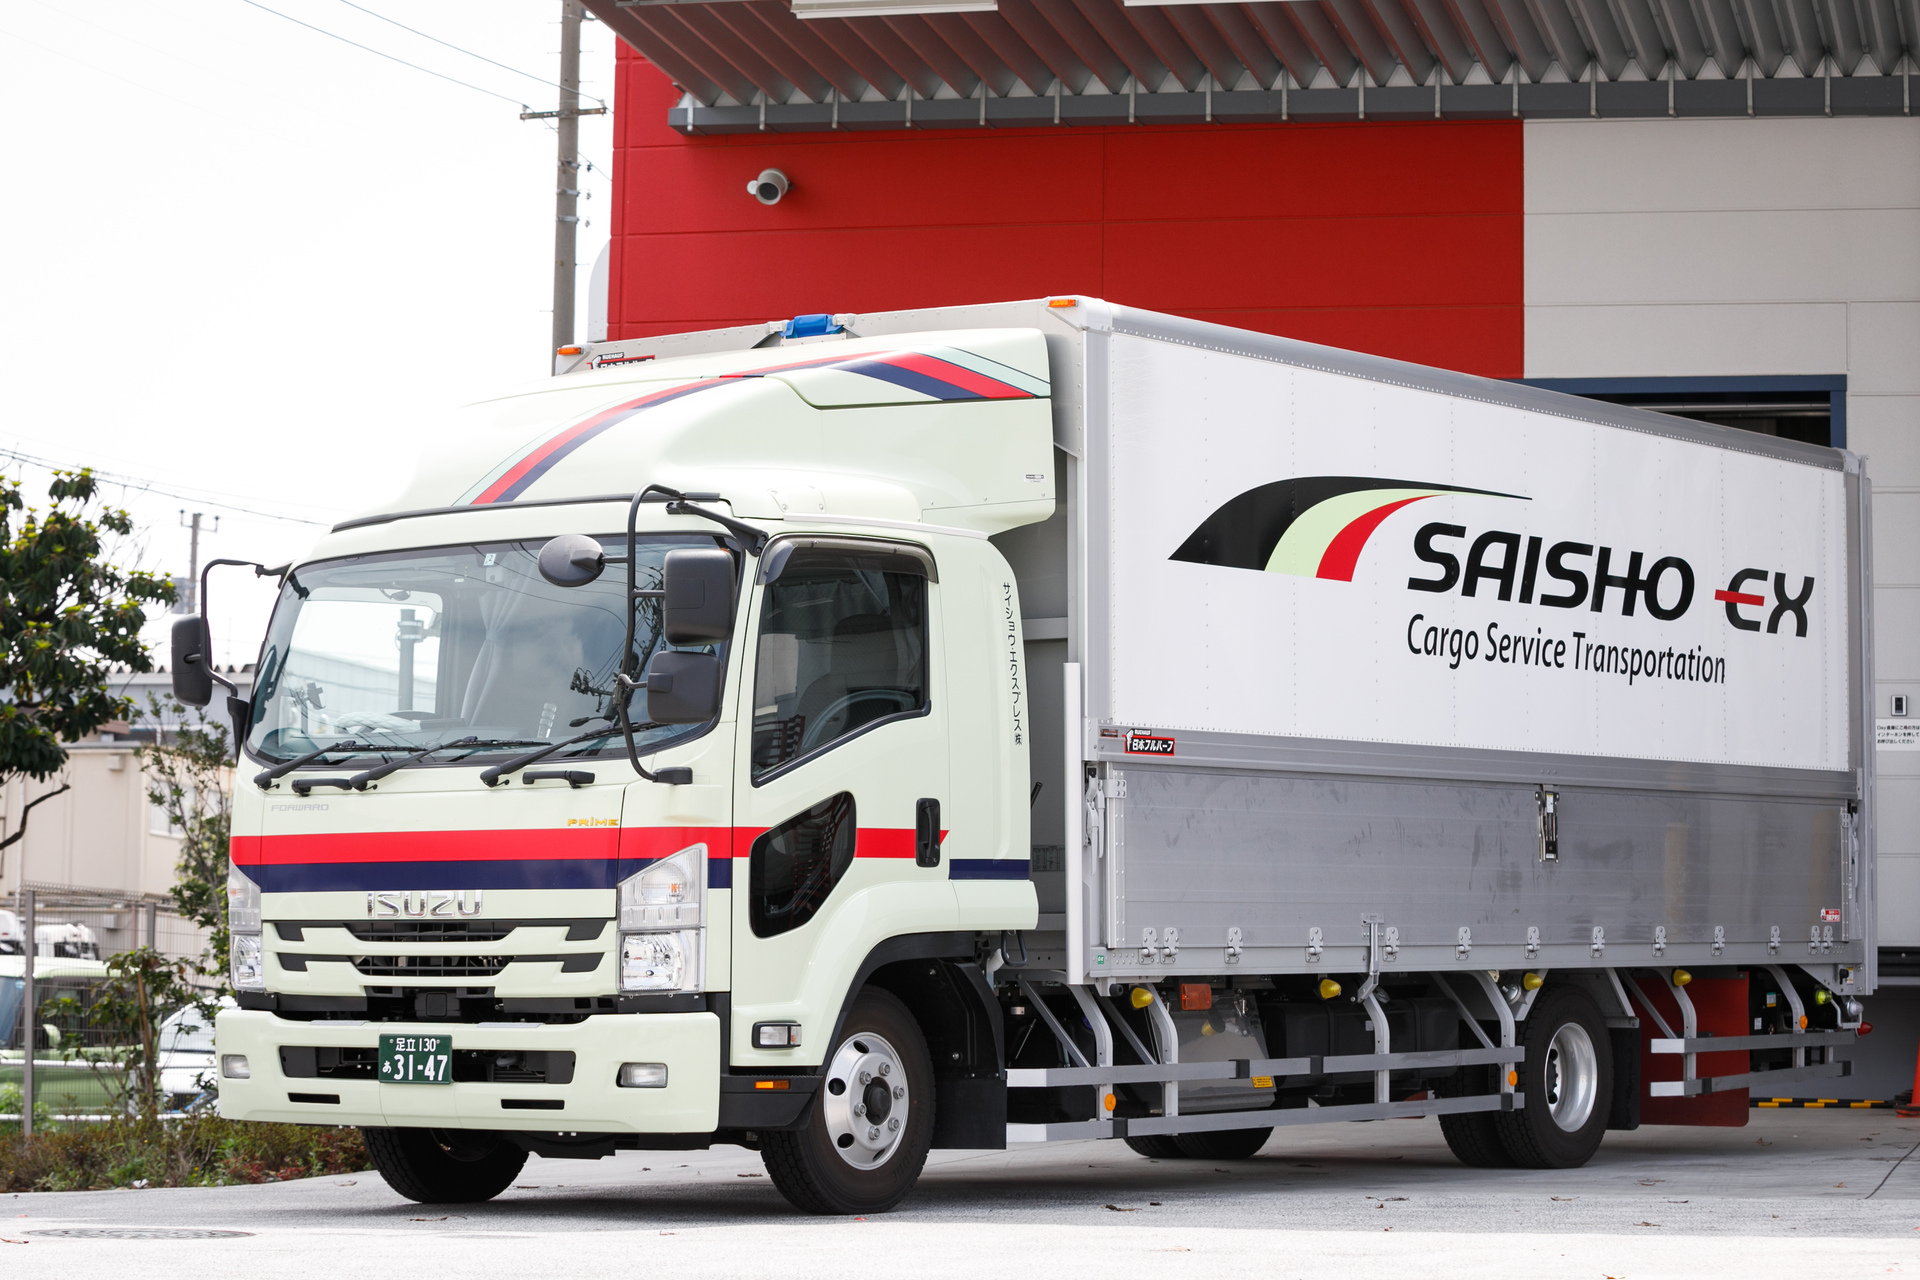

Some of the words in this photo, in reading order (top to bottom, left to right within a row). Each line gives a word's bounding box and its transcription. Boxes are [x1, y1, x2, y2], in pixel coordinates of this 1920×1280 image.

[1407, 522, 1695, 621] SAISHO
[1714, 568, 1815, 638] EX
[1407, 614, 1479, 670] Cargo
[1484, 622, 1566, 669] Service
[1572, 631, 1725, 686] Transportation
[1132, 739, 1174, 752] 日本フルハーフ
[271, 804, 329, 812] FORWARD
[367, 890, 482, 918] ISUZU
[395, 1037, 416, 1052] 足立
[418, 1038, 436, 1052] 130
[382, 1060, 392, 1074] あ
[393, 1054, 448, 1081] 31-47
